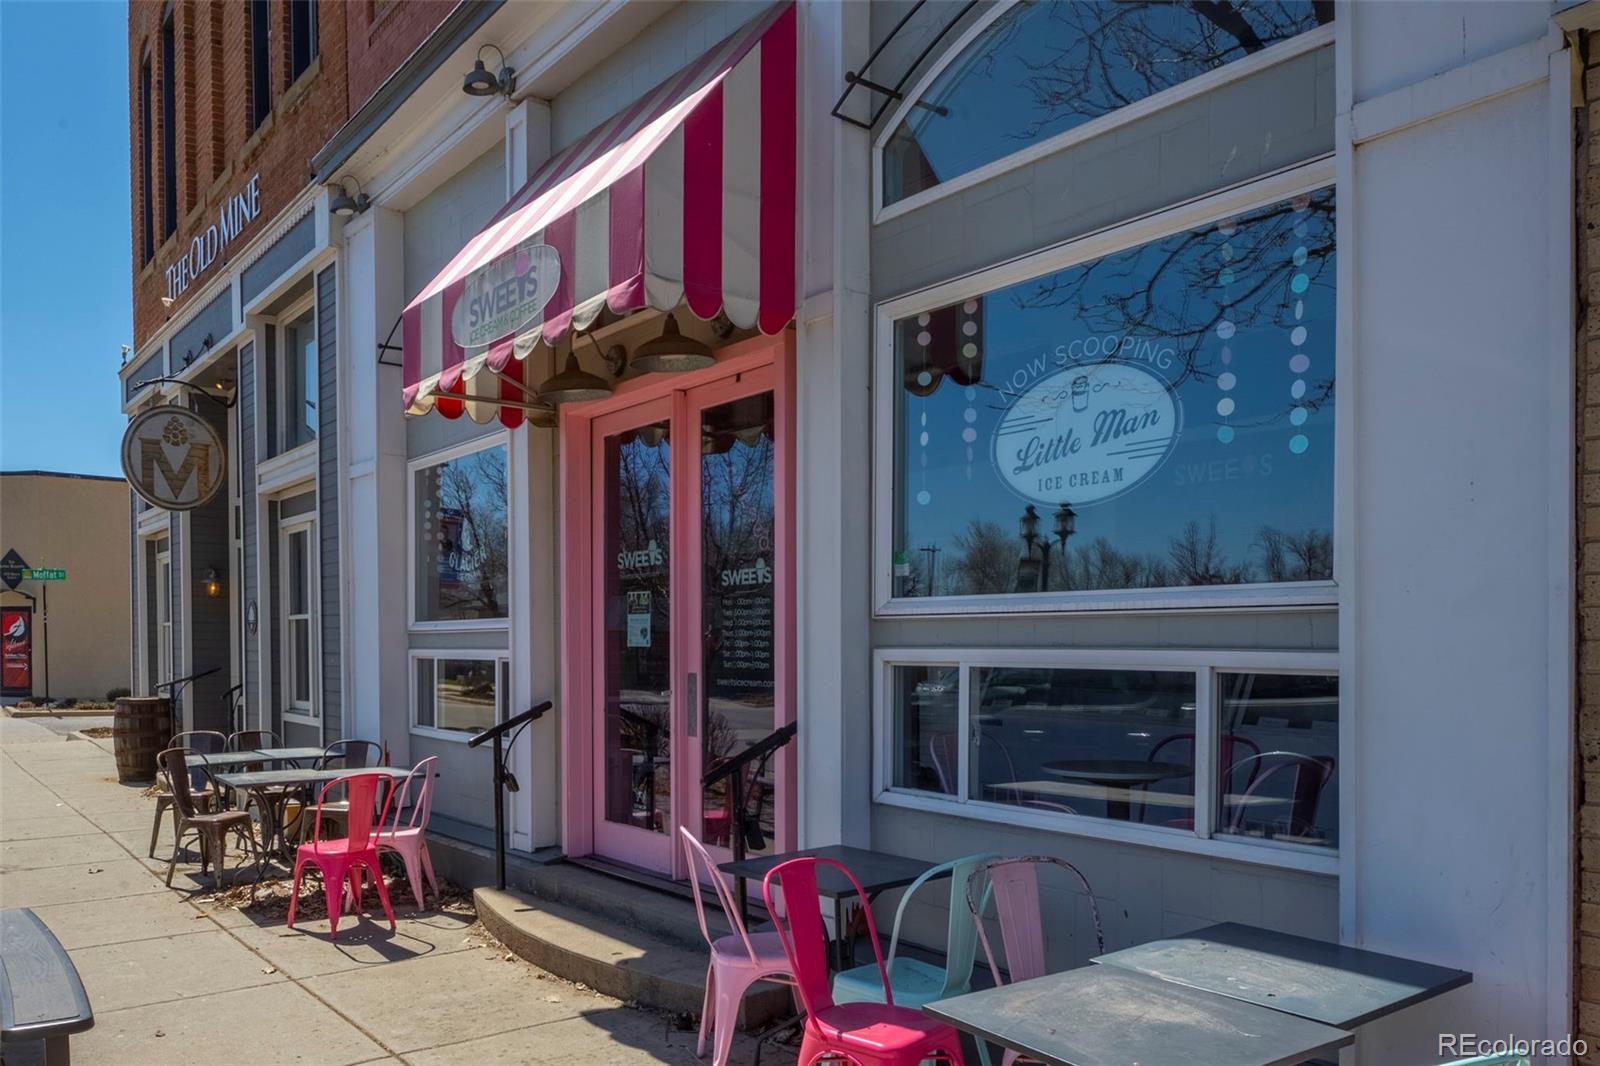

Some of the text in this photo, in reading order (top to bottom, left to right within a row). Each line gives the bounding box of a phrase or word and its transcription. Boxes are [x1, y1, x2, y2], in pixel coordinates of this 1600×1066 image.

[166, 172, 261, 300] THE OLD MINE
[999, 335, 1176, 402] NOW SCOOPING
[1012, 407, 1161, 476] Little Man
[1037, 467, 1125, 492] ICE CREAM
[32, 570, 58, 579] Moffat
[449, 547, 487, 572] GLACIER
